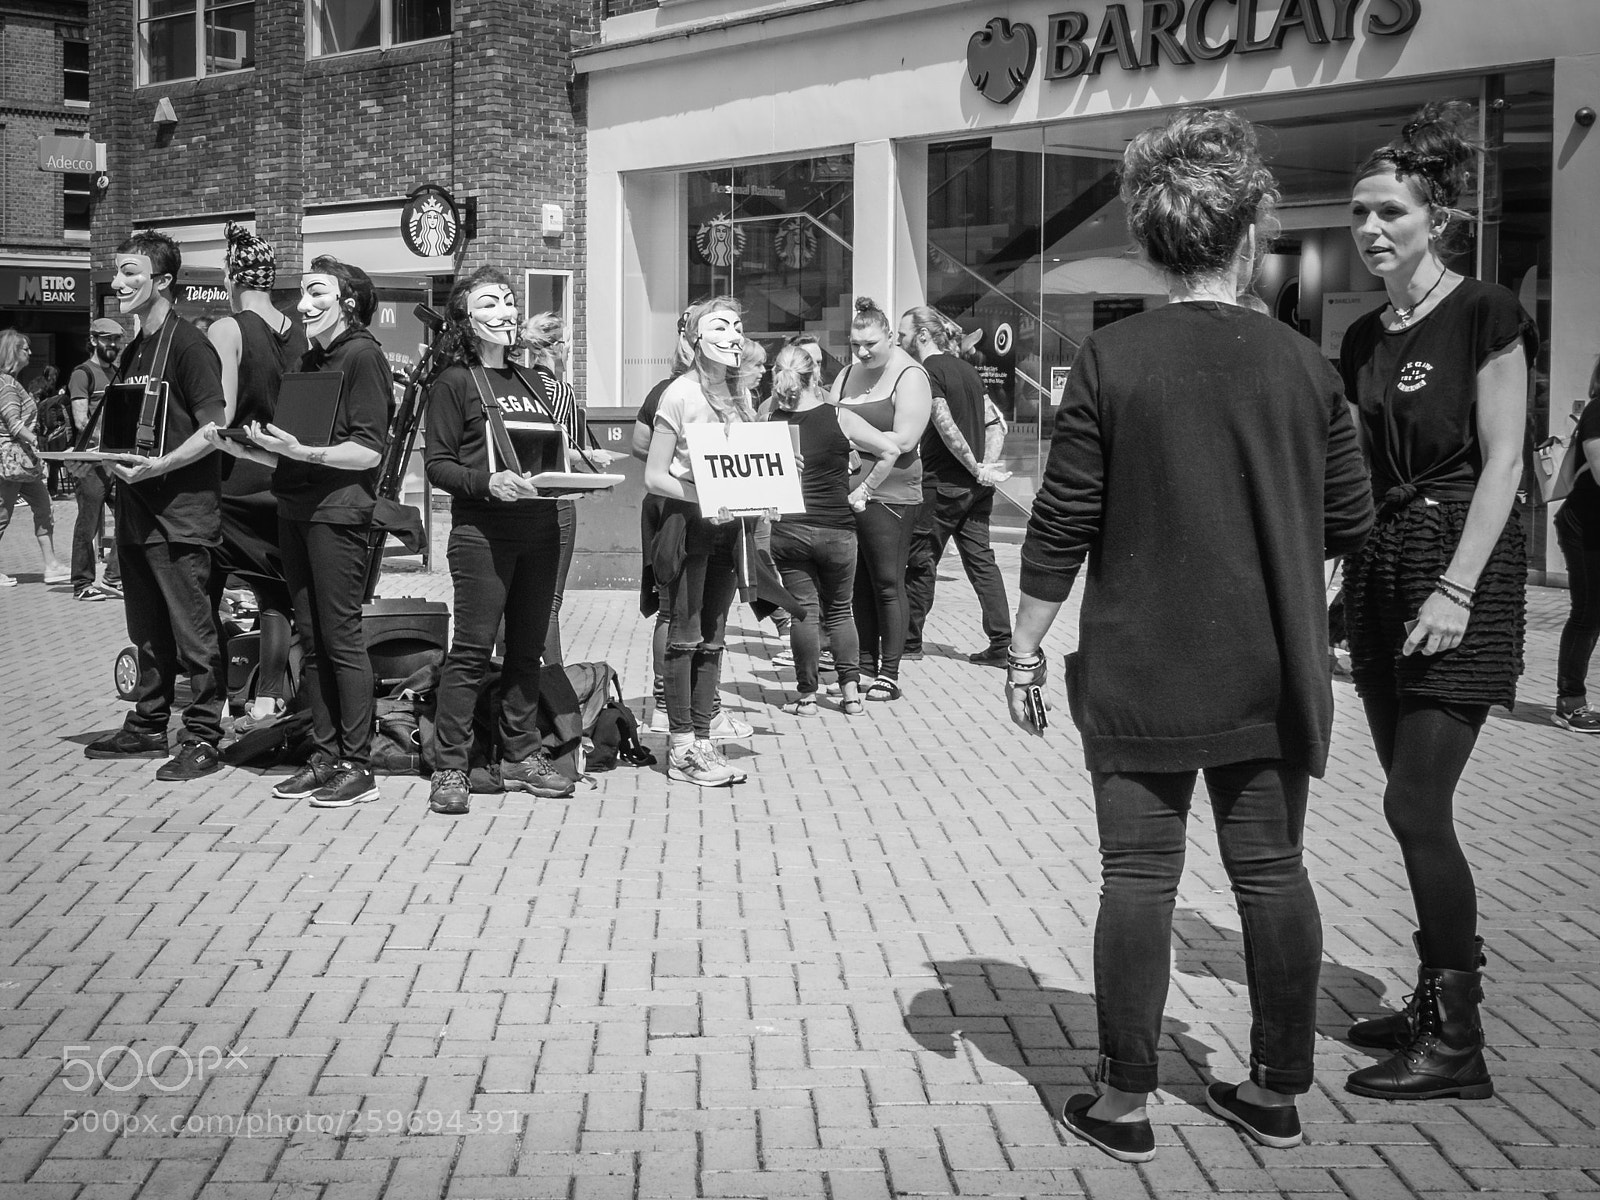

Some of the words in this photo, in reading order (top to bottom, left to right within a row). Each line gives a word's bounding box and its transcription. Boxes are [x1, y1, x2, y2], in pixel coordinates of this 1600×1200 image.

[45, 155, 93, 170] Adecco
[43, 291, 76, 302] BANK
[496, 395, 549, 416] EGAN
[607, 426, 622, 441] 18
[704, 453, 784, 478] TRUTH
